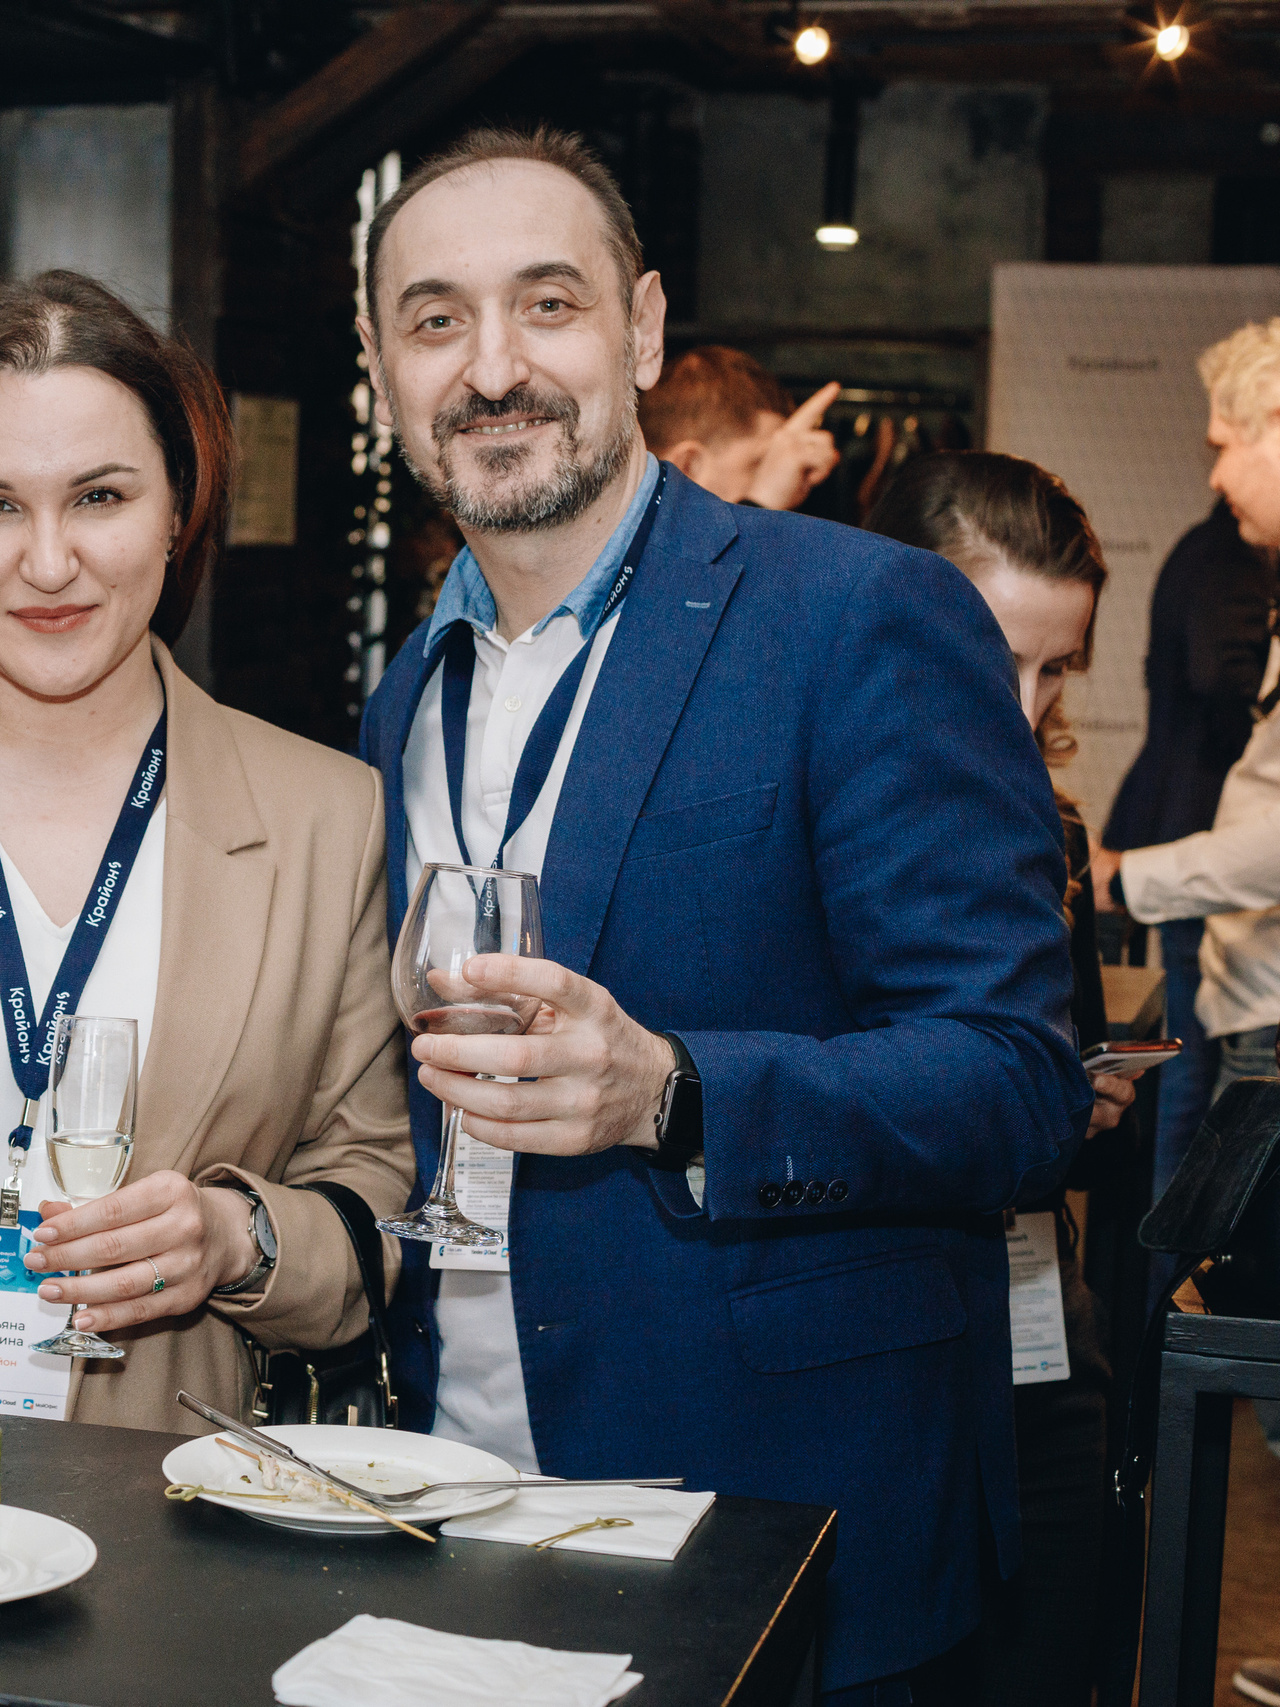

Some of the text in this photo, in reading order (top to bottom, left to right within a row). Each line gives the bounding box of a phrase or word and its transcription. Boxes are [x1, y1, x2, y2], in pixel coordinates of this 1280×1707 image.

[131, 755, 162, 808] Крайон
[85, 868, 119, 927] Крайон
[8, 987, 30, 1054] Крайон
